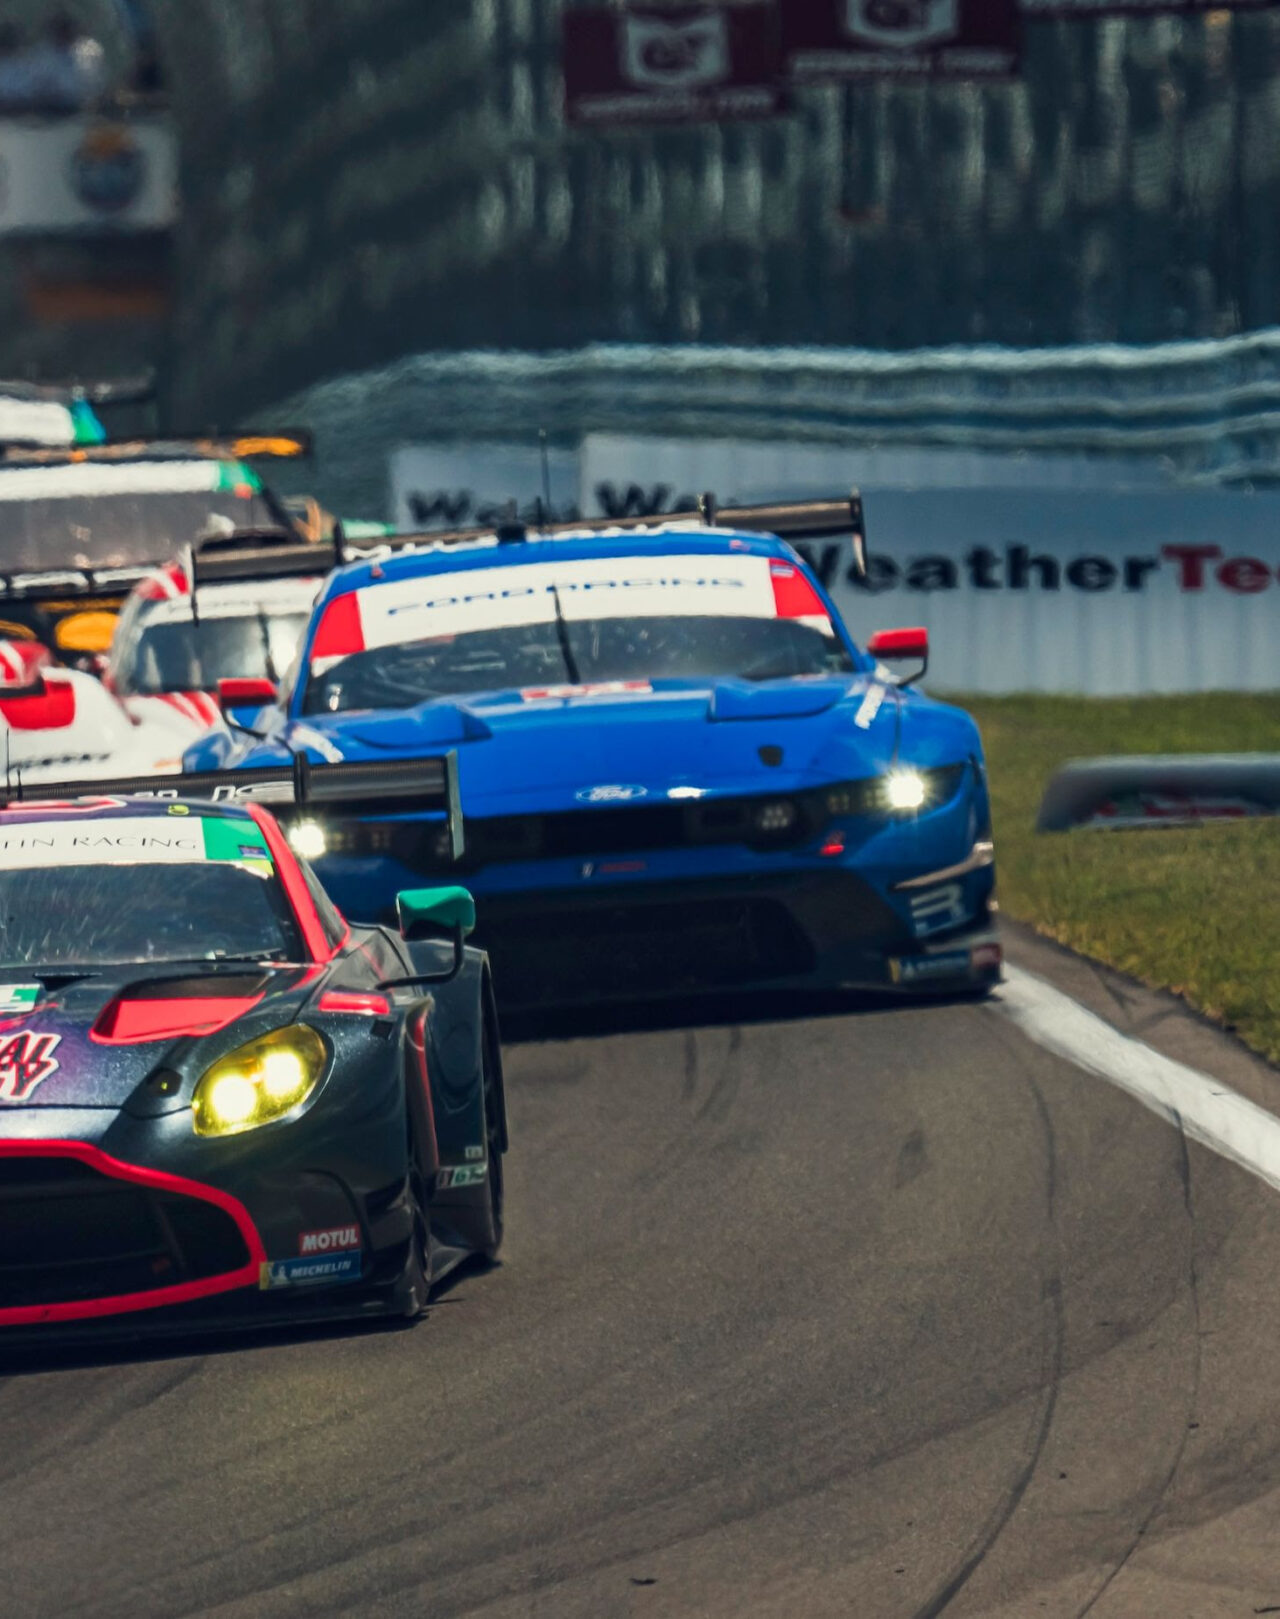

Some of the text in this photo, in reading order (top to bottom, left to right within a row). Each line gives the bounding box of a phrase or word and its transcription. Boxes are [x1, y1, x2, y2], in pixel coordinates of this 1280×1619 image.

[802, 544, 1280, 593] eatherTe
[72, 834, 198, 851] RACING
[302, 1229, 359, 1250] MOTUL
[290, 1260, 352, 1278] MICHELIN
